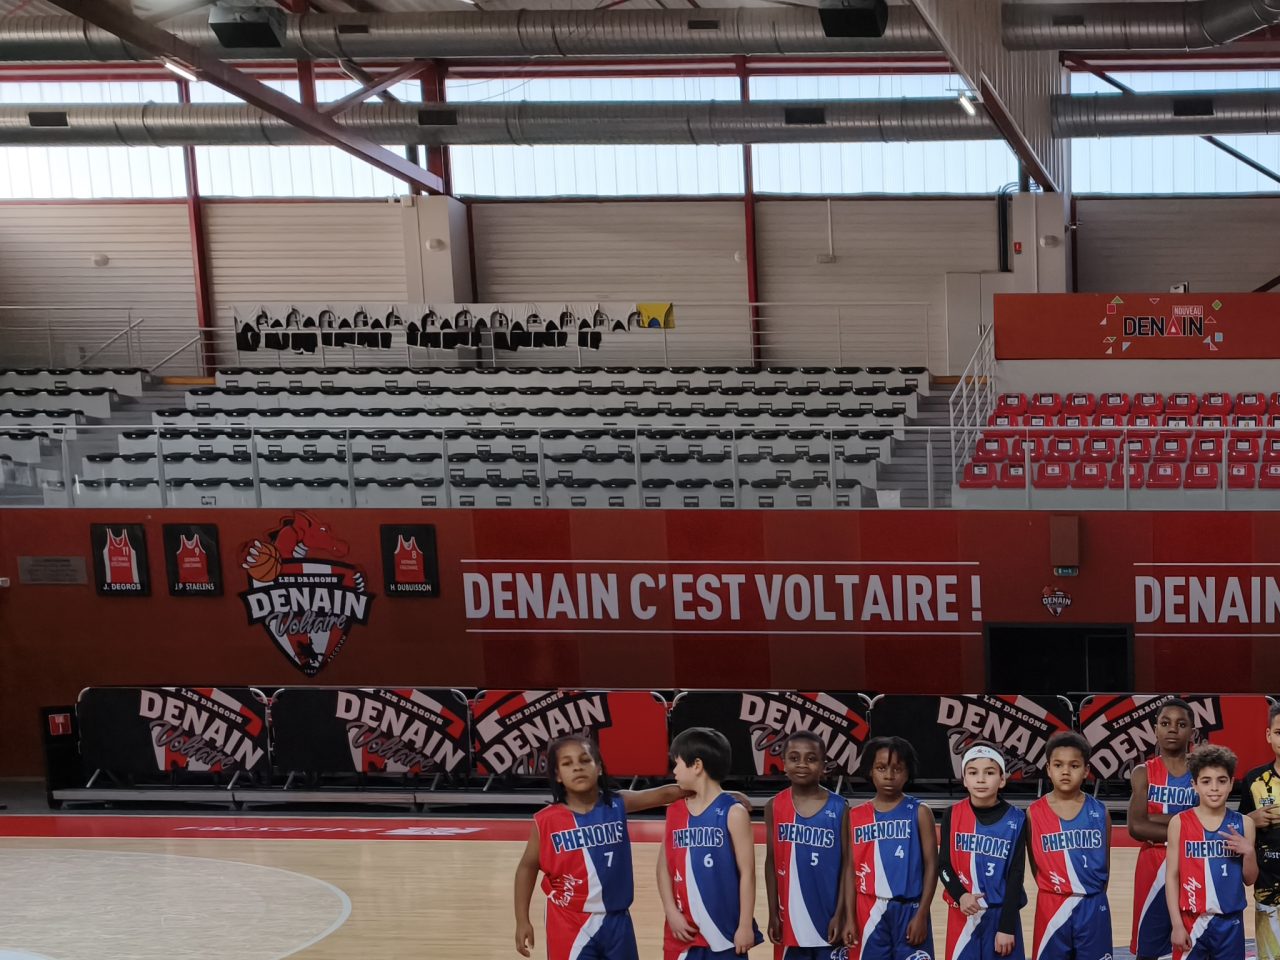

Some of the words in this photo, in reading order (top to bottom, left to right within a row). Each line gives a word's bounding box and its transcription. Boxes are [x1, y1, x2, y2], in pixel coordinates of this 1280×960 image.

[1174, 306, 1202, 315] NOUVEAU
[1123, 316, 1203, 337] DENAIN
[122, 546, 129, 556] 11
[194, 548, 200, 556] 9
[411, 550, 417, 559] 8
[397, 584, 432, 592] DUBUISSON
[462, 572, 619, 620] DENAIN
[630, 572, 745, 621] C'EST
[754, 574, 958, 622] VOLTAIRE
[1042, 596, 1071, 605] DENAIN
[247, 587, 368, 619] DENAIN
[265, 609, 347, 637] Voltaire
[181, 688, 200, 701] LES
[201, 696, 243, 724] DRAGONS
[380, 690, 399, 703] LES
[400, 699, 443, 725] DRAGONS
[505, 713, 523, 726] LES
[523, 690, 564, 716] DRAGONS
[785, 692, 804, 705] LES
[805, 701, 848, 728] DRAGONS
[983, 694, 1003, 711] LES
[1003, 702, 1048, 731] DRAGONS
[139, 689, 264, 771] DENAIN
[335, 691, 466, 773] DENAIN
[482, 695, 606, 774] DENAIN
[739, 692, 864, 775] DENAIN
[936, 697, 1050, 773] DENAI
[1112, 716, 1130, 729] LES
[149, 720, 235, 769] Voltaire
[346, 721, 435, 771] Voltaire
[1089, 698, 1217, 779] DENN
[1148, 784, 1197, 806] HENOM
[551, 821, 624, 853] PHENOMS
[672, 827, 724, 848] PHENOMS
[954, 832, 1012, 859] PHENOMS
[1040, 829, 1102, 852] PHENOMS
[1185, 840, 1241, 858] PHENO
[603, 851, 614, 868] 7
[703, 853, 714, 868] 6
[810, 852, 819, 867] 5
[894, 845, 905, 859] 4
[985, 862, 995, 877] 3
[1221, 863, 1228, 877] 1
